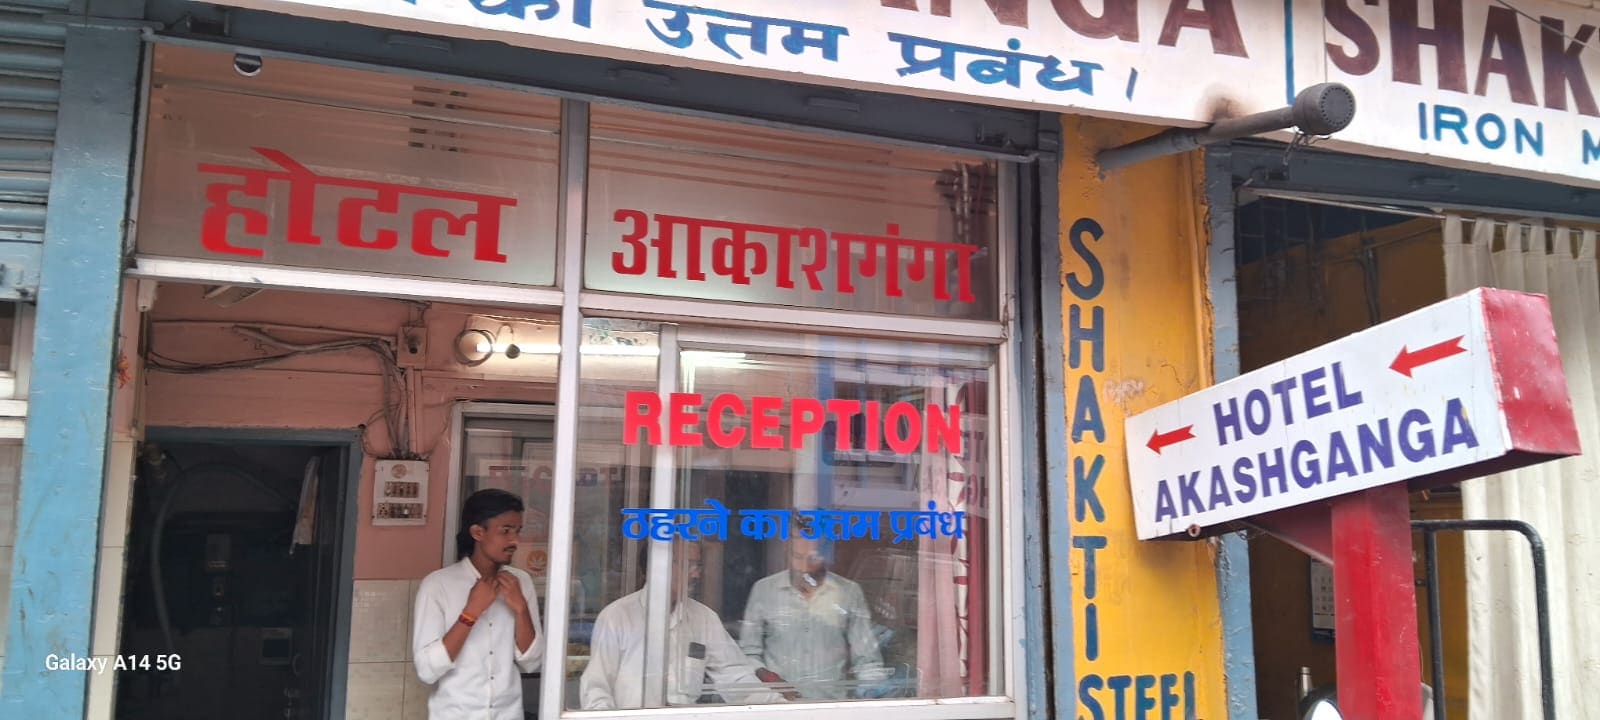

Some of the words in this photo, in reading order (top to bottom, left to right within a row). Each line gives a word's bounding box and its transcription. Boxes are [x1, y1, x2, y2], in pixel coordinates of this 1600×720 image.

[643, 0, 849, 61] उत्तम
[1324, 0, 1600, 117] SHAK
[1418, 102, 1544, 156] IRON
[197, 146, 517, 263] होटल
[611, 208, 980, 303] आकाशगंगा
[623, 390, 961, 454] RECEPTION
[1065, 217, 1107, 661] SHAKTI
[1213, 361, 1363, 446] HOTEL
[1154, 397, 1480, 523] AKASHGANGA
[621, 499, 731, 541] ठहरने
[739, 508, 792, 541] का
[800, 509, 881, 542] उत्तम
[889, 500, 966, 545] प्रबंध
